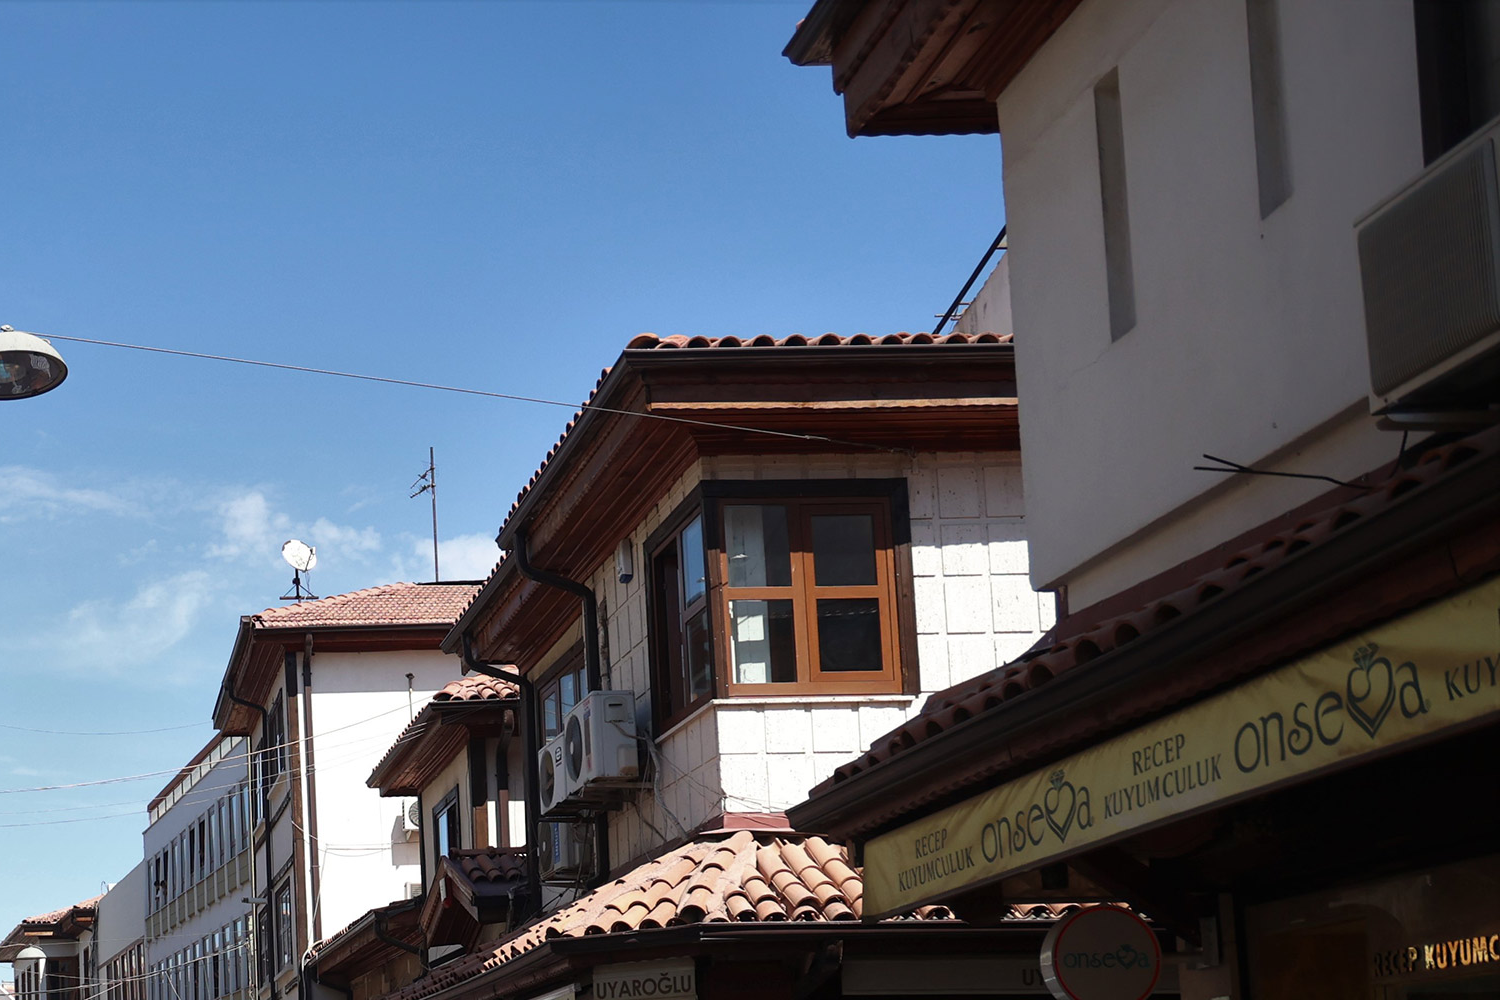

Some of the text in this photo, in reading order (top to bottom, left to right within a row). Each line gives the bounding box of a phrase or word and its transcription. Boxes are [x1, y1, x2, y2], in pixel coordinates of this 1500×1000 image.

[1132, 733, 1185, 776] RECEP
[1104, 754, 1221, 819] KUYUMCULUK
[915, 828, 948, 859] RECEP
[897, 845, 975, 892] KUYUMCULUK
[596, 972, 692, 999] UYAROĞLU
